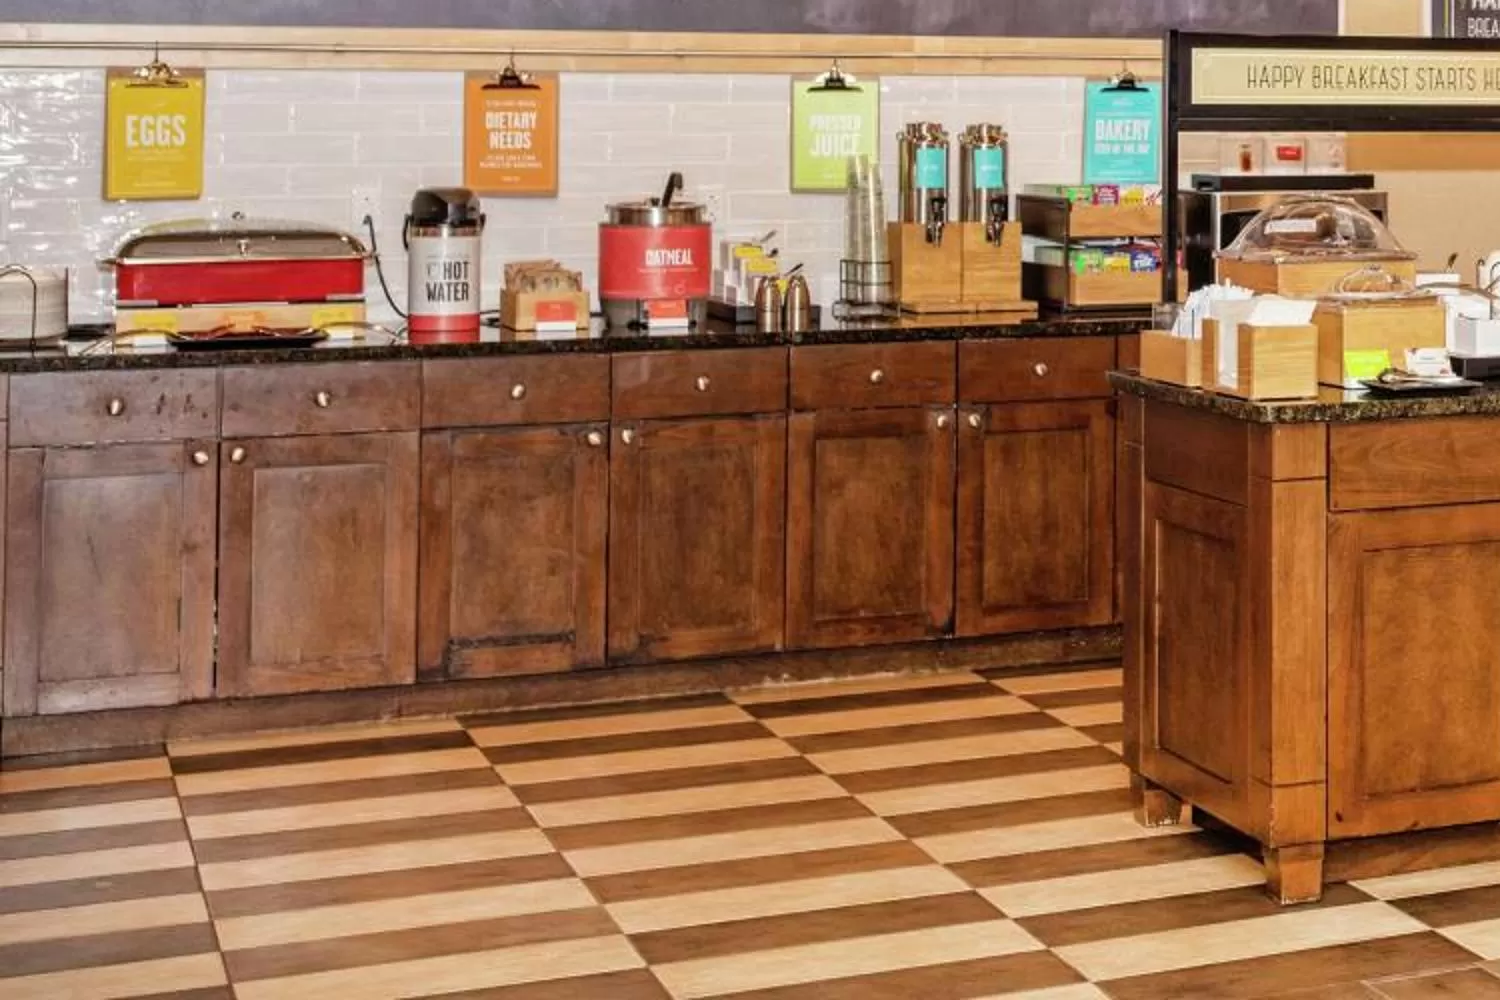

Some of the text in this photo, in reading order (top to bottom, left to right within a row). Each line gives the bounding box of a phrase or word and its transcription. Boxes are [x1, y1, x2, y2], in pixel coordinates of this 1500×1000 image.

[1247, 65, 1304, 89] HAPPY
[1311, 66, 1409, 90] BREAKFAST
[1415, 67, 1477, 91] STARTS
[485, 111, 537, 129] DIETARY
[1095, 119, 1151, 141] BAKERY
[126, 114, 187, 148] EGGS
[489, 132, 532, 149] NEEDS
[811, 134, 862, 156] JUICE
[645, 248, 693, 266] OATMEAL
[443, 261, 470, 280] HOT
[426, 281, 470, 301] WATER
